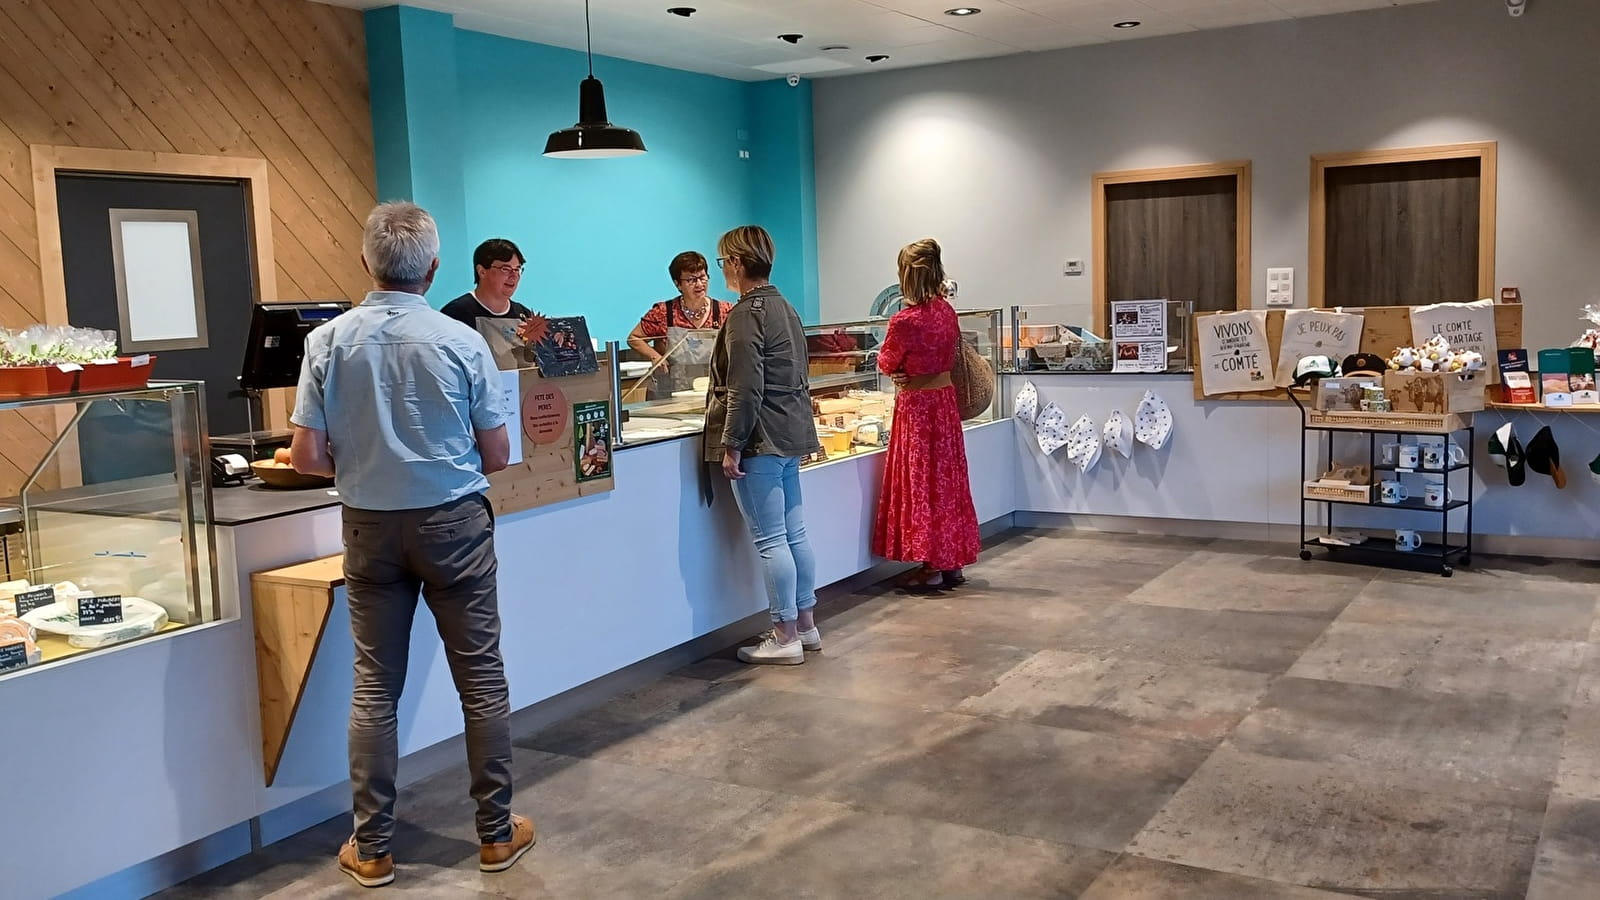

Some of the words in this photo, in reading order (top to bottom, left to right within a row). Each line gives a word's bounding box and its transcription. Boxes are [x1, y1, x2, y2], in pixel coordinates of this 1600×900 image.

[1213, 320, 1253, 338] VIVONS
[1297, 322, 1307, 336] JE
[1309, 321, 1332, 334] PEUX
[1331, 326, 1347, 342] PAS
[1432, 323, 1443, 335] LE
[1448, 332, 1484, 345] PARTAGE
[1221, 353, 1259, 372] COMTÉ
